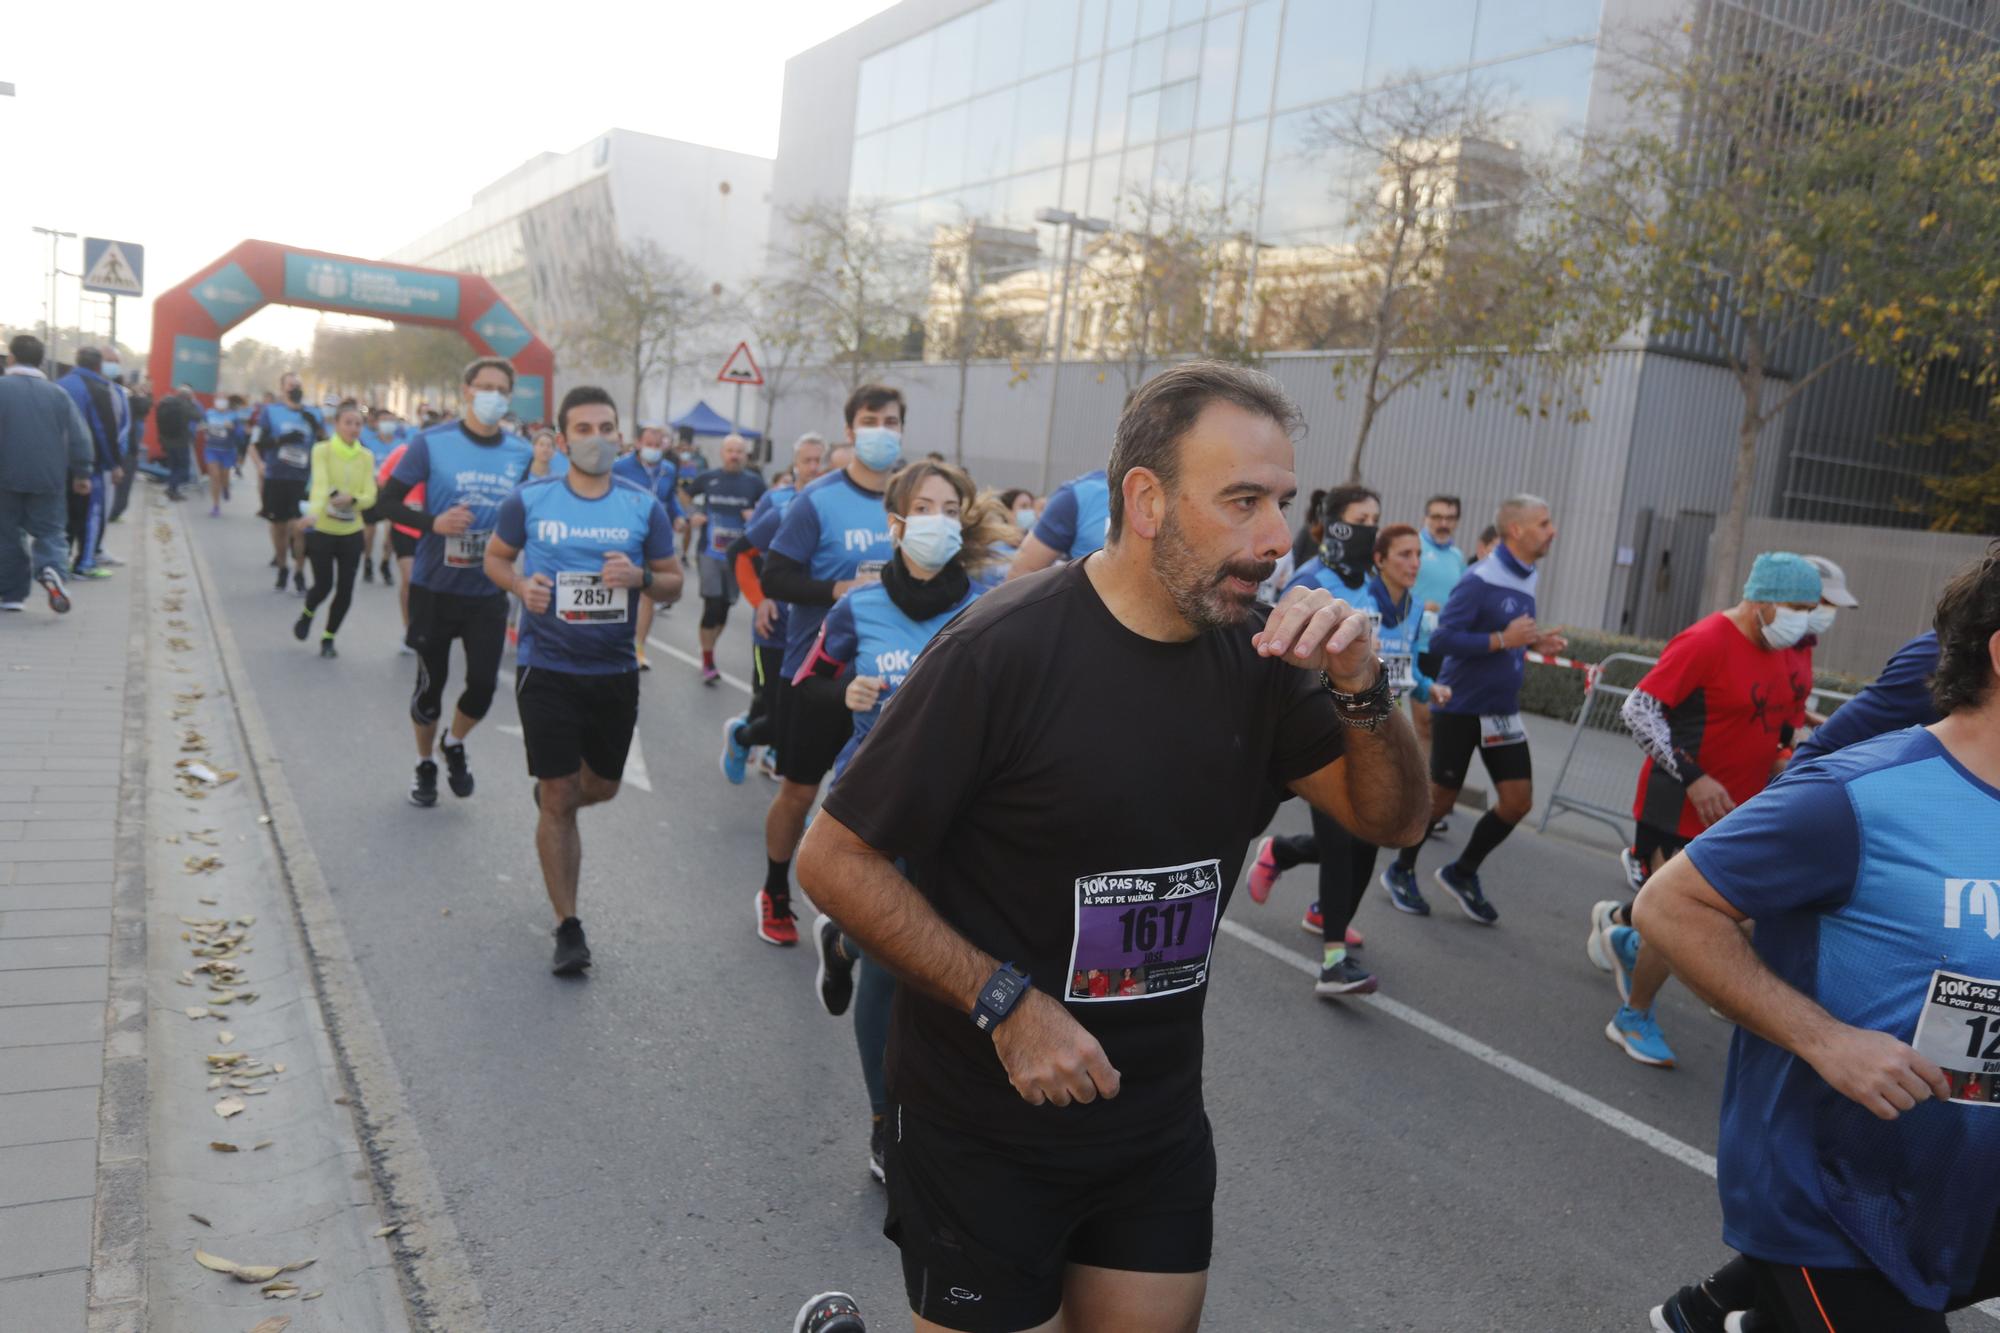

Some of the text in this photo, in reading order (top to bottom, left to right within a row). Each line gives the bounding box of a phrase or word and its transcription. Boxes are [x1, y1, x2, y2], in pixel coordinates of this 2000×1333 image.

[571, 528, 629, 540] MARTICO
[574, 588, 613, 606] 2857
[875, 650, 910, 673] 10K
[1083, 876, 1157, 896] 10K PAS RAS
[1084, 892, 1154, 905] AL PORT DE VALÈNCIA
[1119, 902, 1192, 953] 1617
[1938, 981, 1997, 1000] 10K PAS
[1937, 996, 1947, 1004] AL
[1949, 998, 1971, 1008] PORT
[1973, 1002, 1985, 1010] DE
